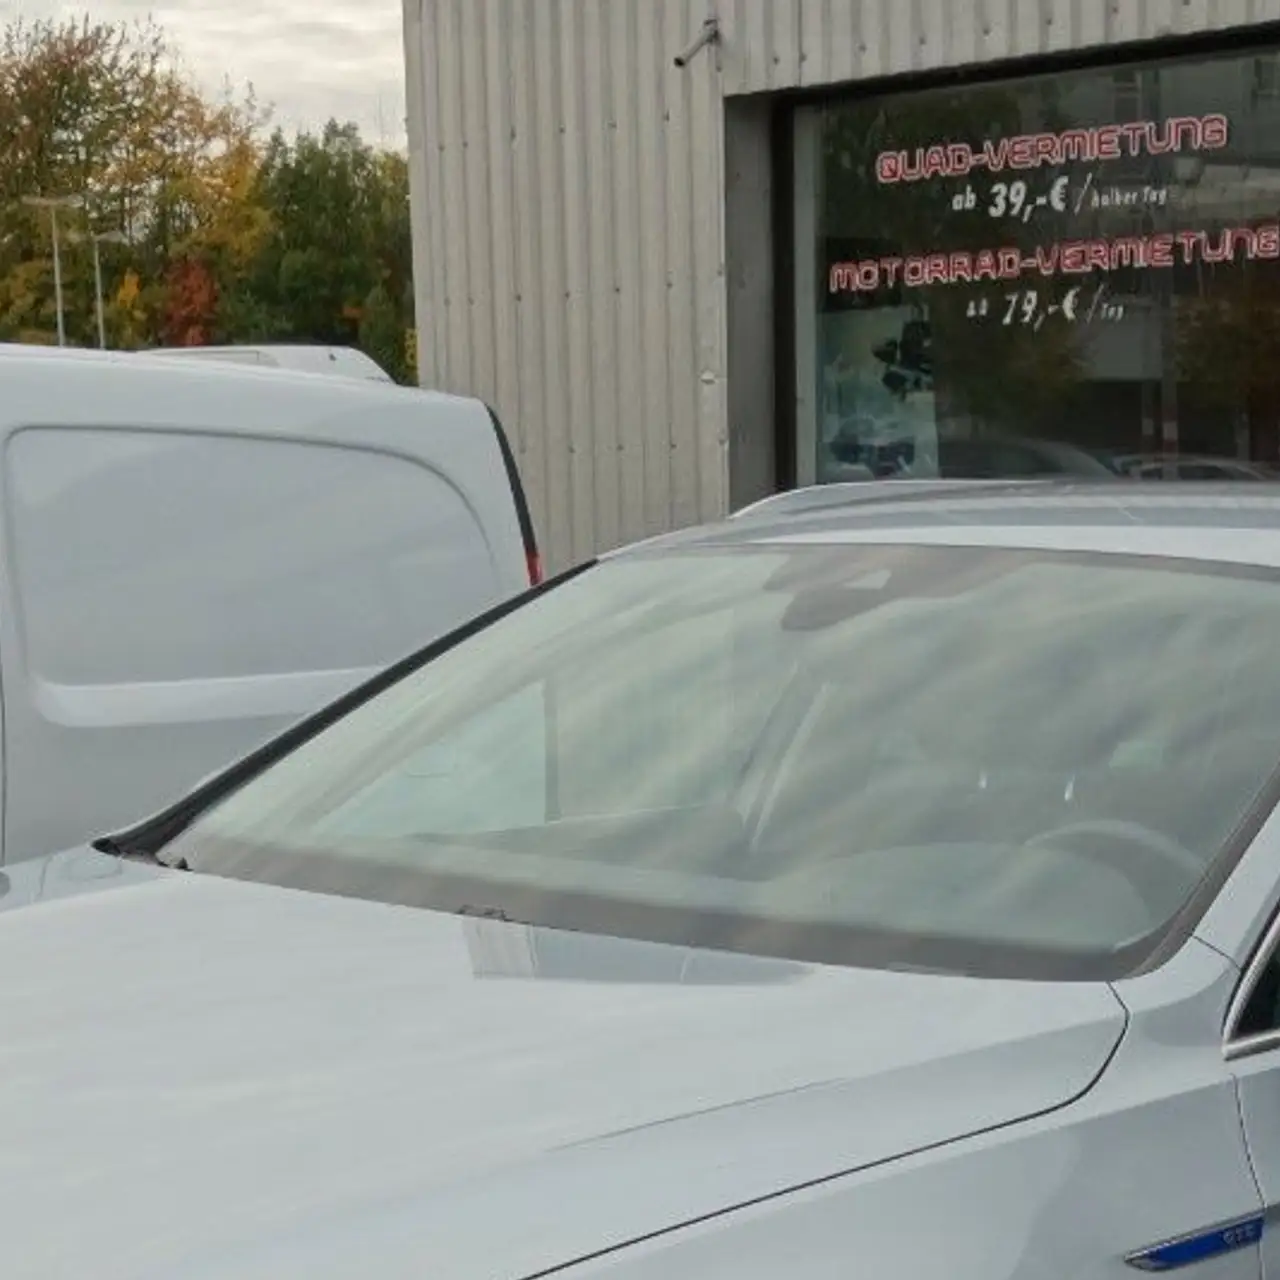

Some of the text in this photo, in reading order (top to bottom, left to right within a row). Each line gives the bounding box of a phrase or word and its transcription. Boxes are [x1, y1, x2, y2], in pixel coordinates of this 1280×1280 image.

[876, 114, 1228, 183] QUAD-VERMIETUNG
[952, 185, 977, 212] ab
[829, 225, 1280, 293] MOTORRAD-VERMIETUNG
